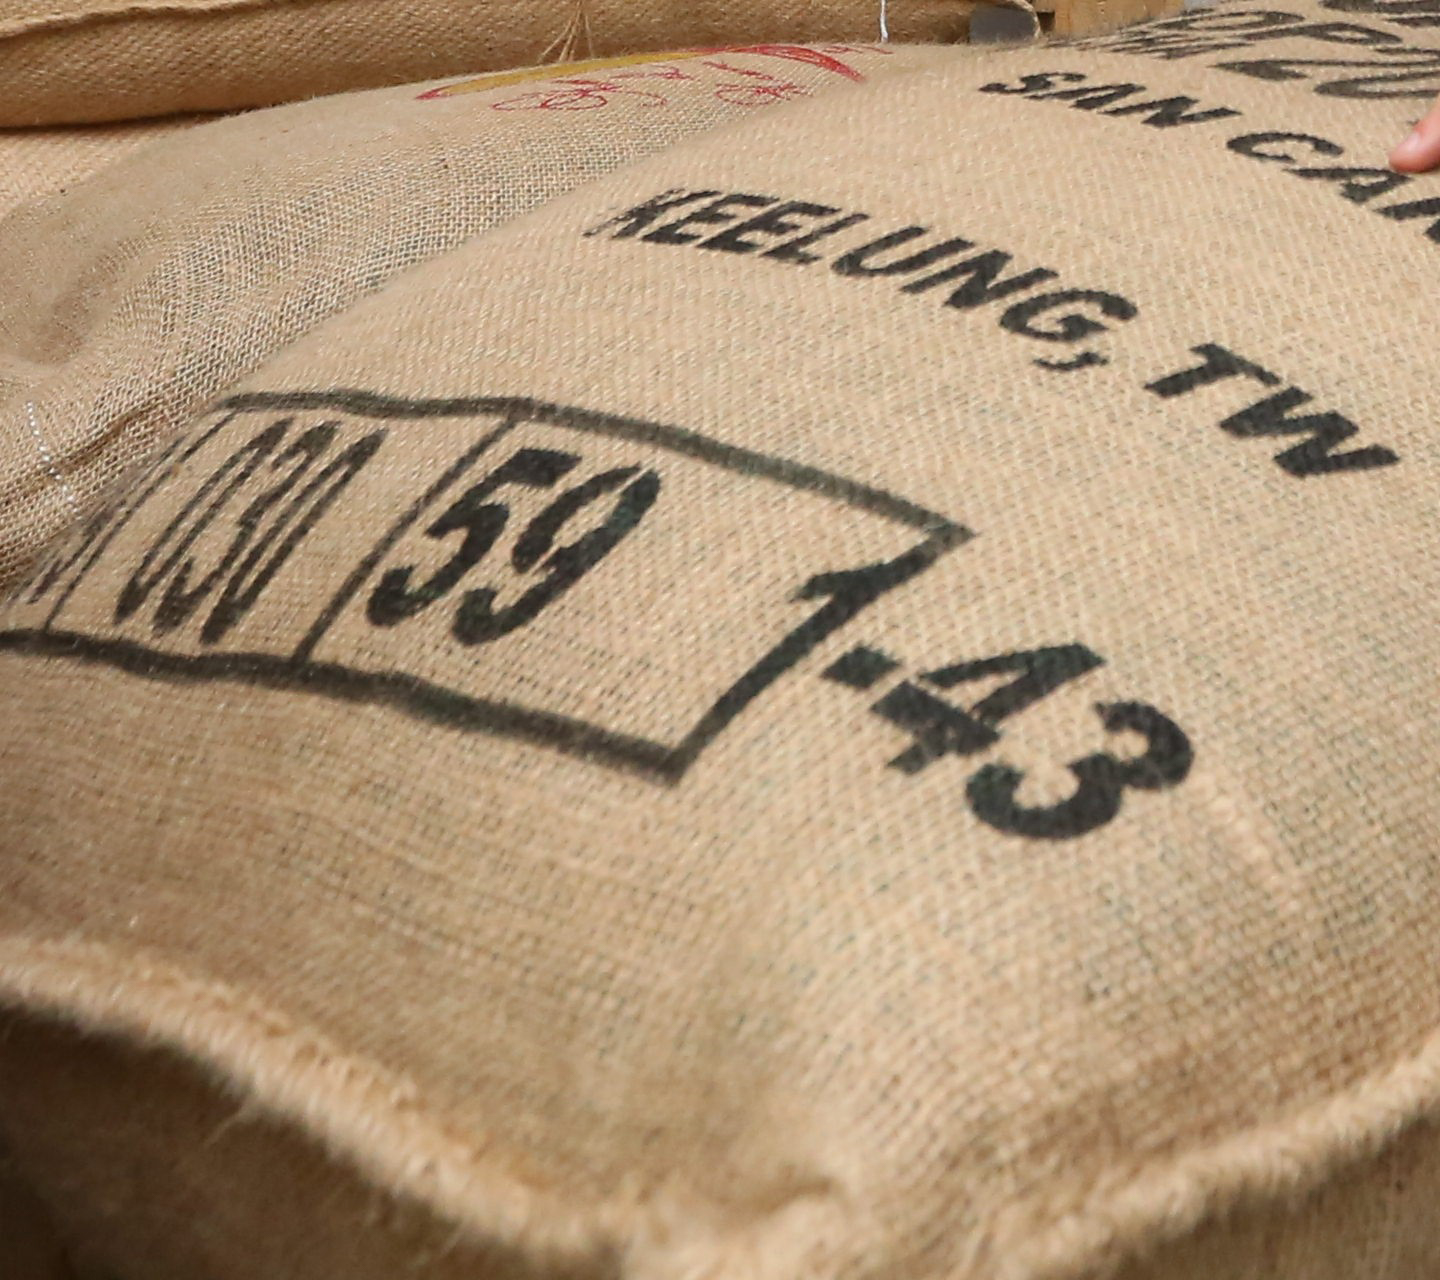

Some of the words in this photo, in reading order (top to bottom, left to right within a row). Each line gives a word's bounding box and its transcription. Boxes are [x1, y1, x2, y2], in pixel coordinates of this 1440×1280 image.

[978, 70, 1242, 128] SAN
[581, 186, 1139, 373] KEELUNG,
[1142, 342, 1402, 478] TW
[367, 447, 663, 648] 59
[788, 535, 1196, 841] 1-43
